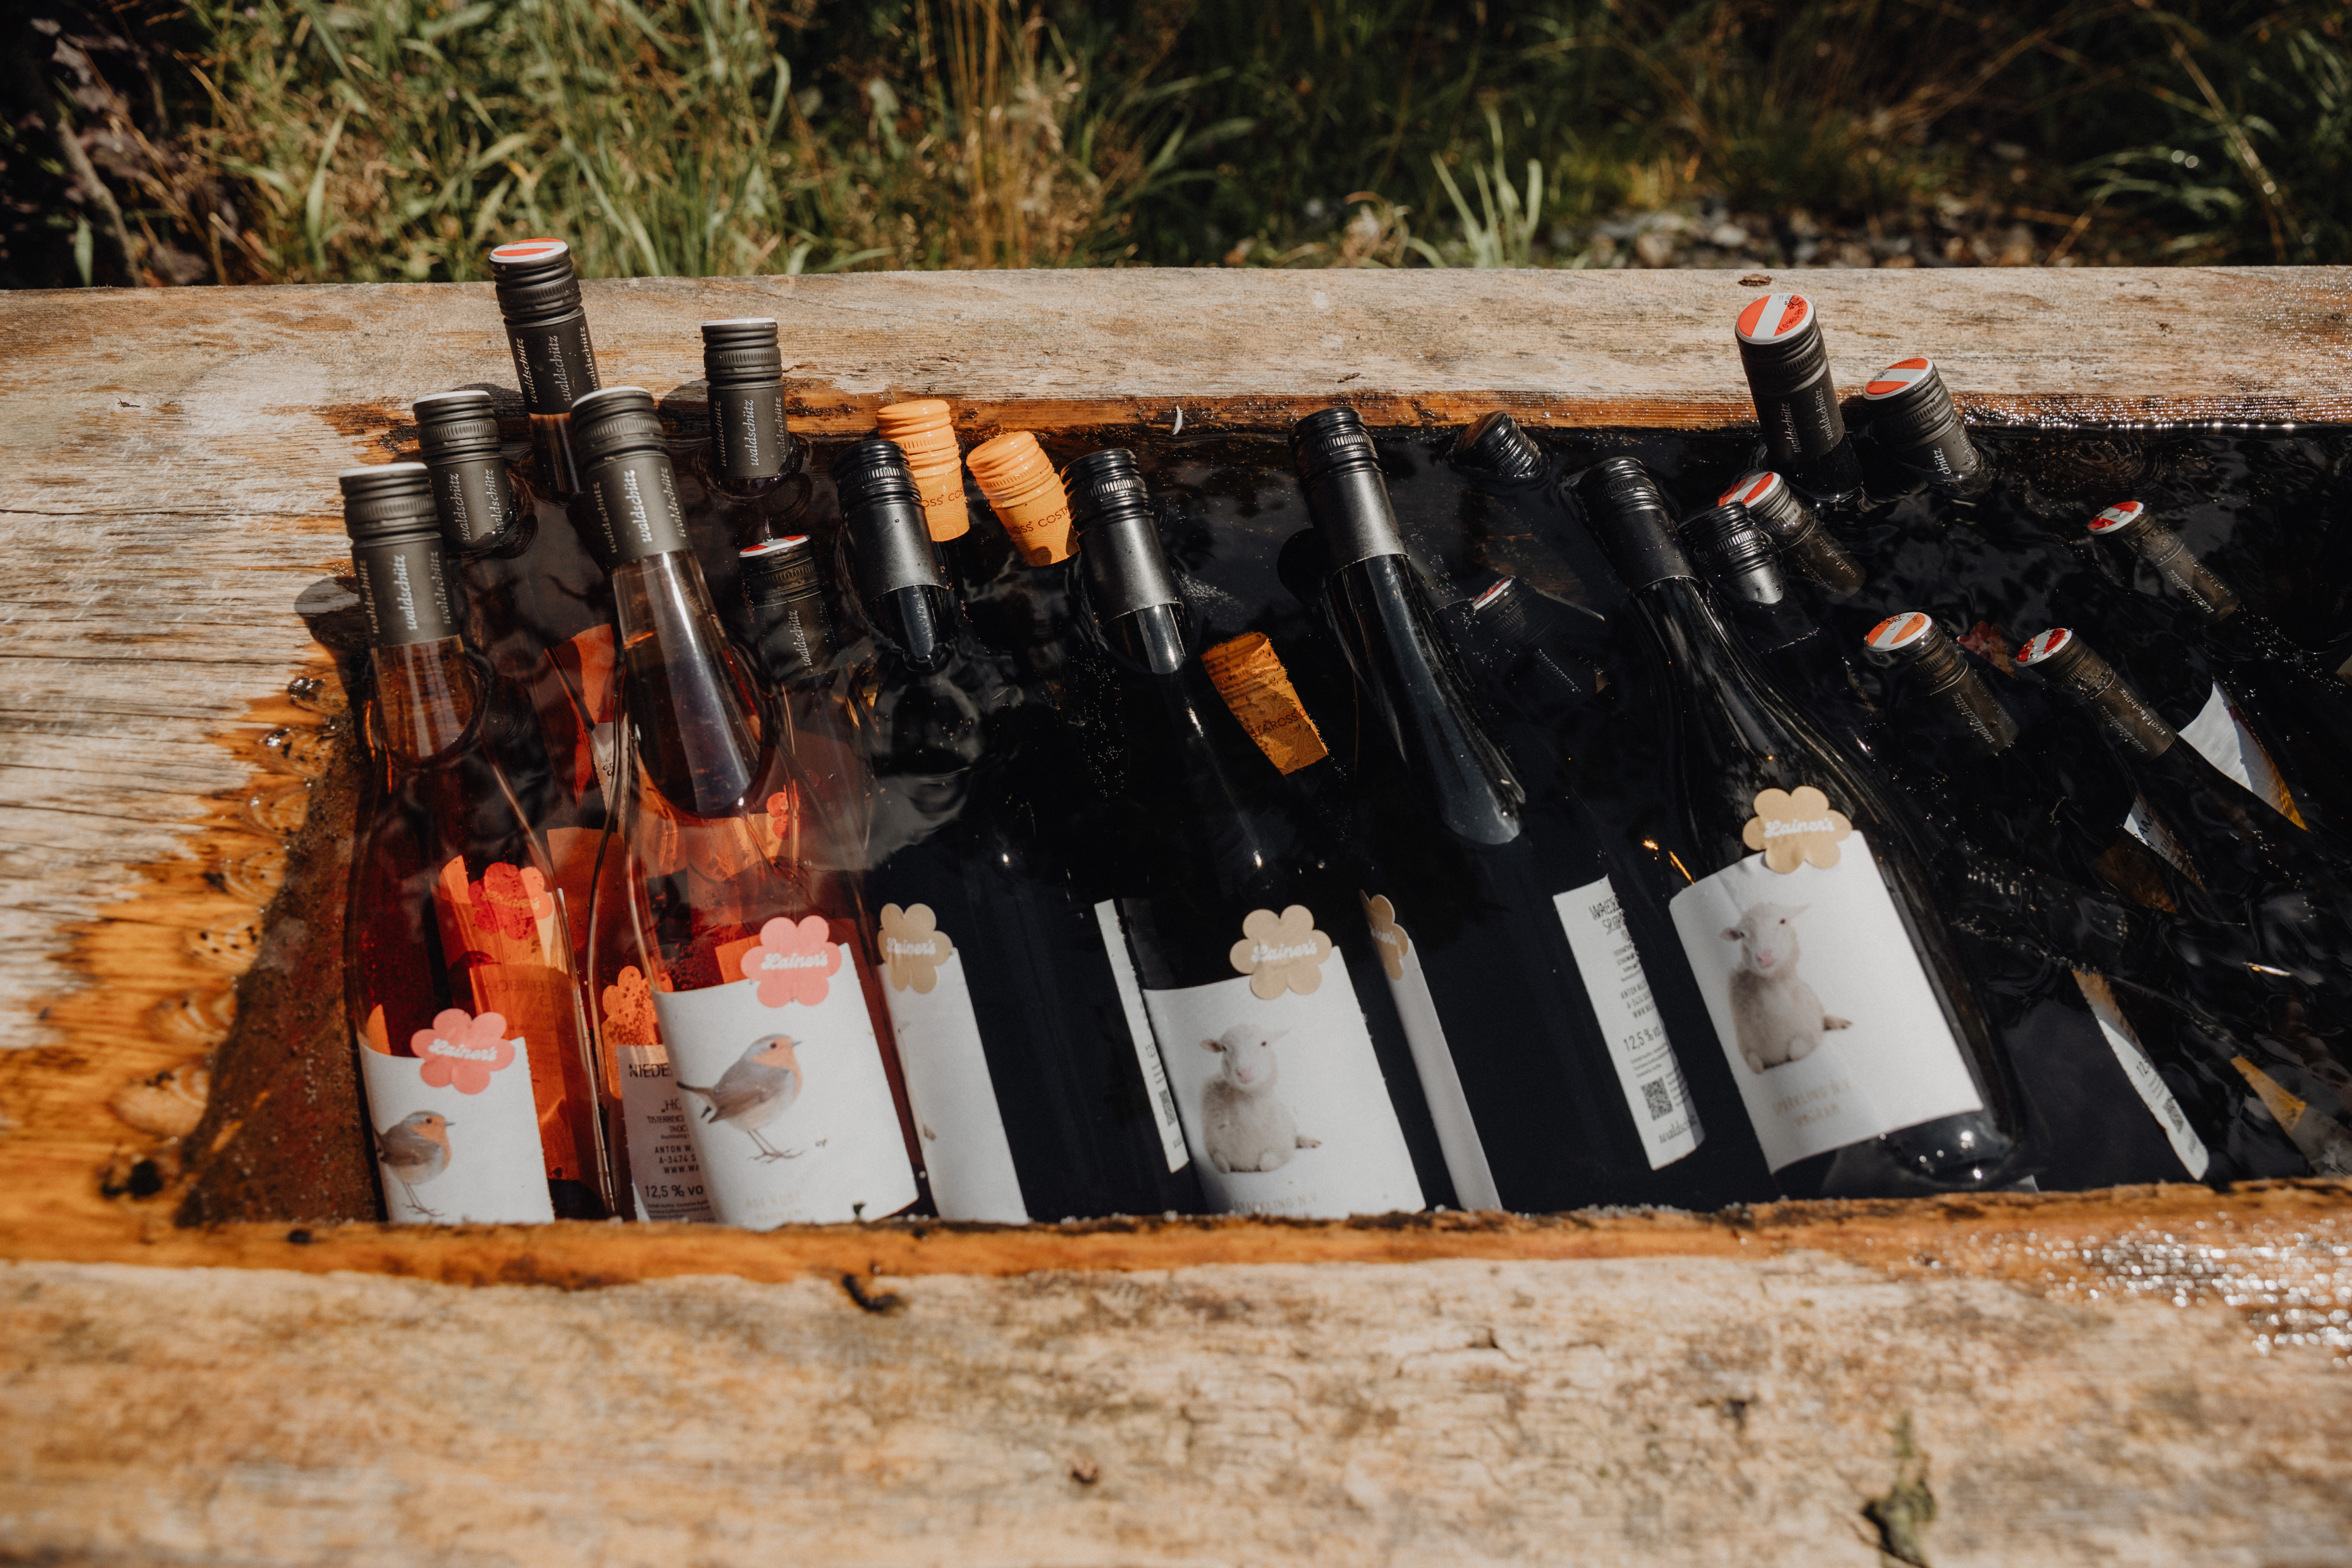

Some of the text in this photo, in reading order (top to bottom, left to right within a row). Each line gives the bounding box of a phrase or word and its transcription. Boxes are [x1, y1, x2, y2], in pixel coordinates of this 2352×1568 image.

[516, 337, 539, 403] waldschütz
[549, 335, 572, 401] waldschütz
[579, 325, 599, 391] waldschütz
[714, 400, 727, 467] waldschütz
[743, 399, 759, 466] waldschütz
[775, 396, 787, 463] waldschütz
[1781, 403, 1802, 453] waldschütz
[1815, 387, 1834, 441] waldschütz
[450, 473, 472, 541] waldschütz
[484, 469, 505, 534] waldschütz
[593, 481, 618, 553] waldschütz
[623, 469, 653, 543] waldschütz
[660, 466, 686, 538] waldschütz
[1816, 536, 1858, 578] waldschütz
[392, 554, 418, 631] waldschütz
[430, 551, 451, 624] waldschütz
[2167, 570, 2214, 614] waldschütz
[788, 609, 813, 667] waldschütz
[1952, 693, 1995, 744] waldschütz
[2098, 705, 2148, 753] waldschütz
[2118, 688, 2166, 736] waldschütz
[1763, 816, 1835, 839] Lainer's
[760, 950, 828, 971] Lainer's
[1250, 938, 1318, 963] Lainer's
[428, 1038, 498, 1062] Lainer's
[1623, 1032, 1645, 1051] 12,5
[629, 1063, 673, 1077] NIEDE
[655, 1145, 681, 1153] ANTON
[659, 1155, 688, 1164] A-3474
[645, 1185, 668, 1199] 12,5
[671, 1185, 685, 1197] %
